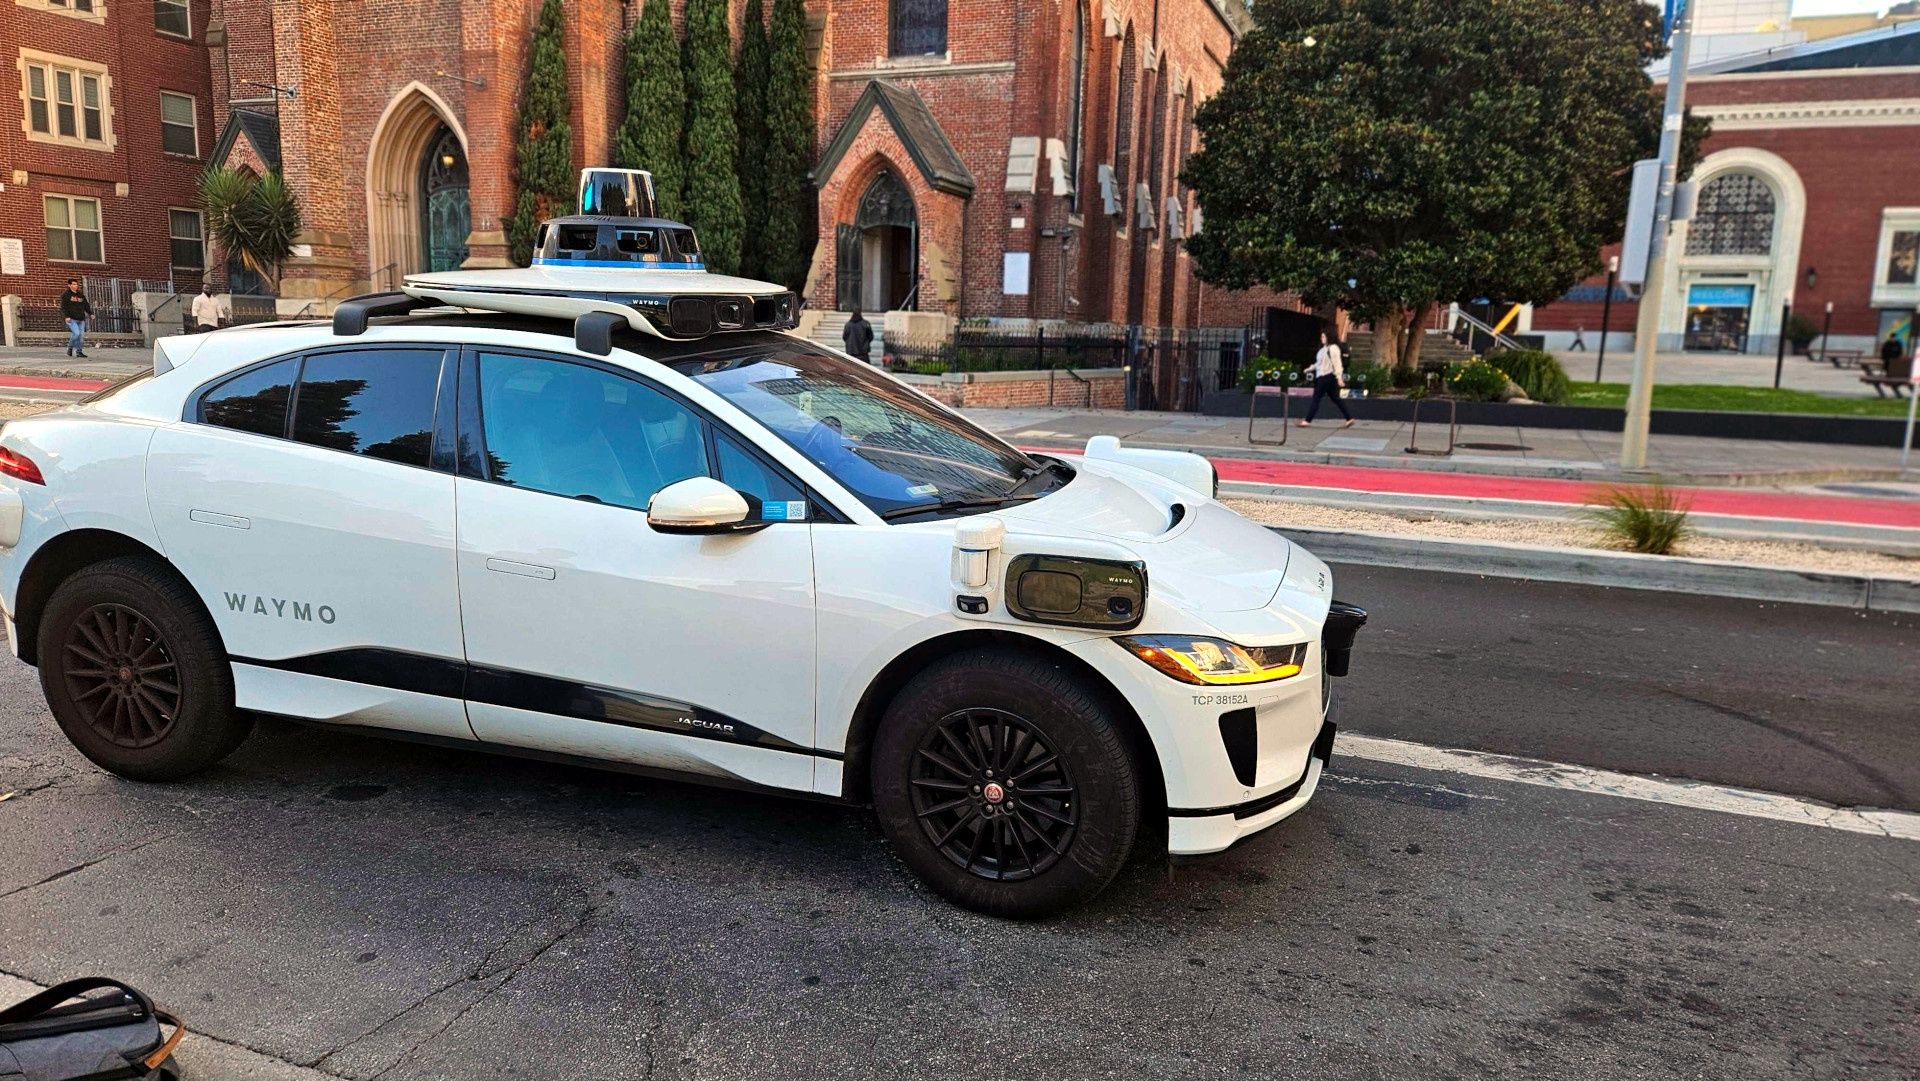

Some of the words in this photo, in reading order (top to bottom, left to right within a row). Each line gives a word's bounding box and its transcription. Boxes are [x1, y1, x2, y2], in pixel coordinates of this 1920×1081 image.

[1108, 576, 1133, 584] WAYMO
[223, 591, 336, 624] WAYMO
[1192, 695, 1213, 706] TCP
[1216, 694, 1248, 705] 38152A
[674, 717, 734, 733] JAGUAR
